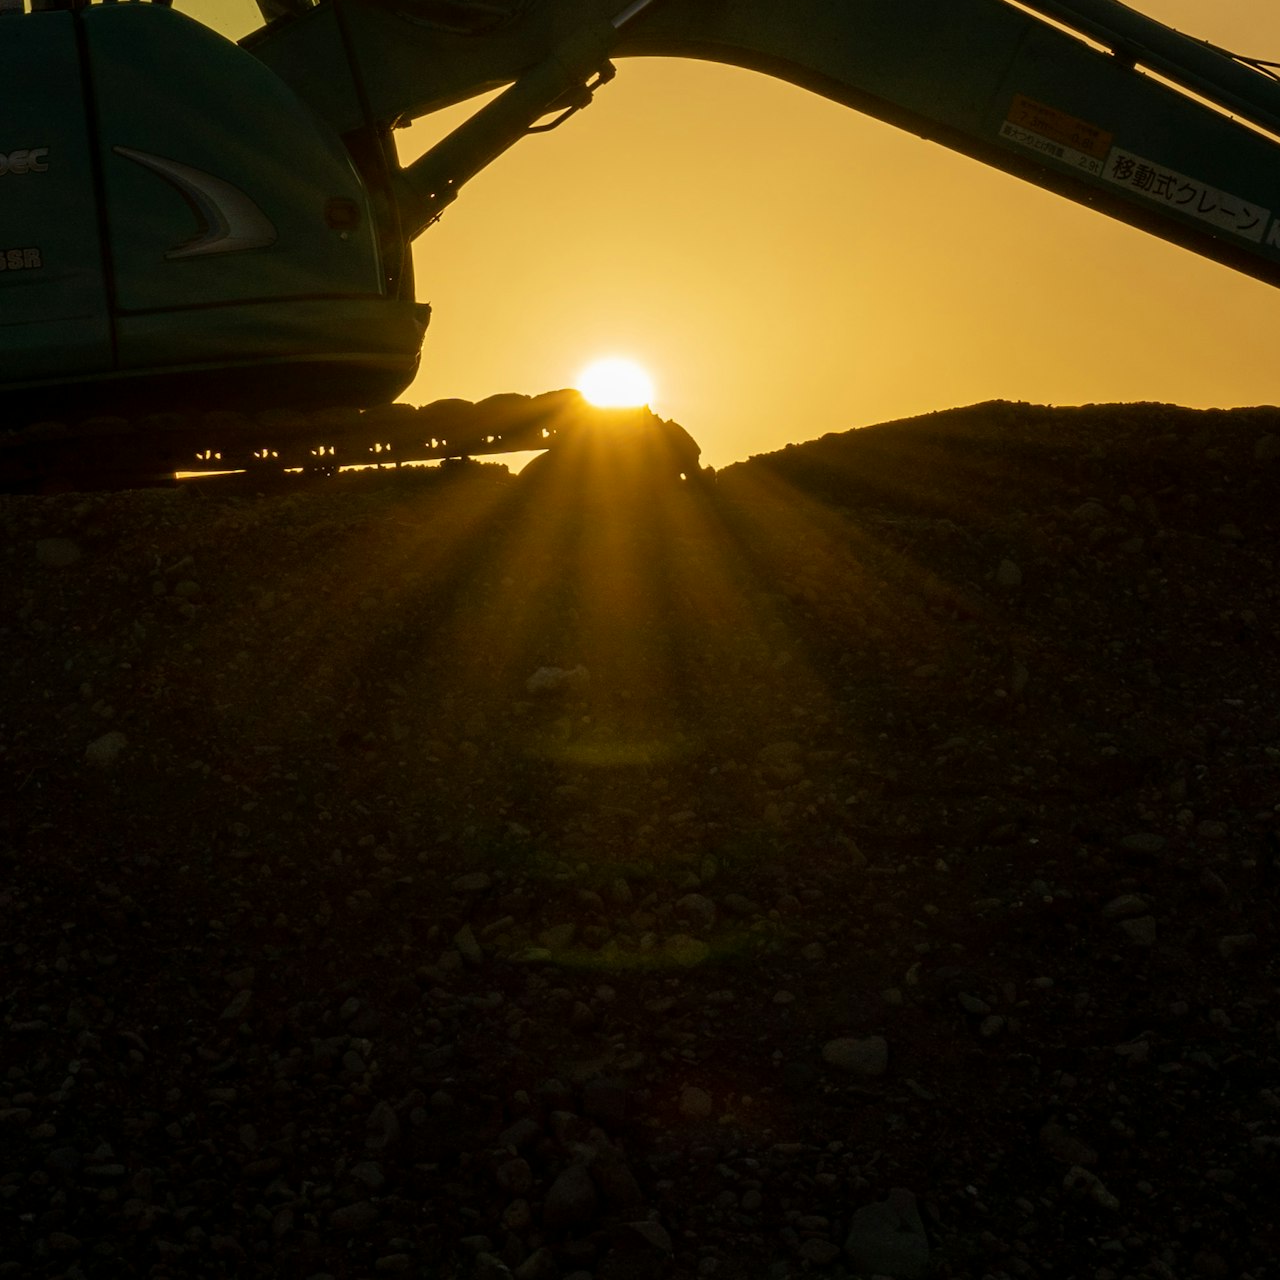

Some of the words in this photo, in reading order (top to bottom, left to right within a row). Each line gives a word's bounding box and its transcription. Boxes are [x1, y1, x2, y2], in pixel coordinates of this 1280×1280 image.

[1111, 154, 1261, 231] 移動式クレーン
